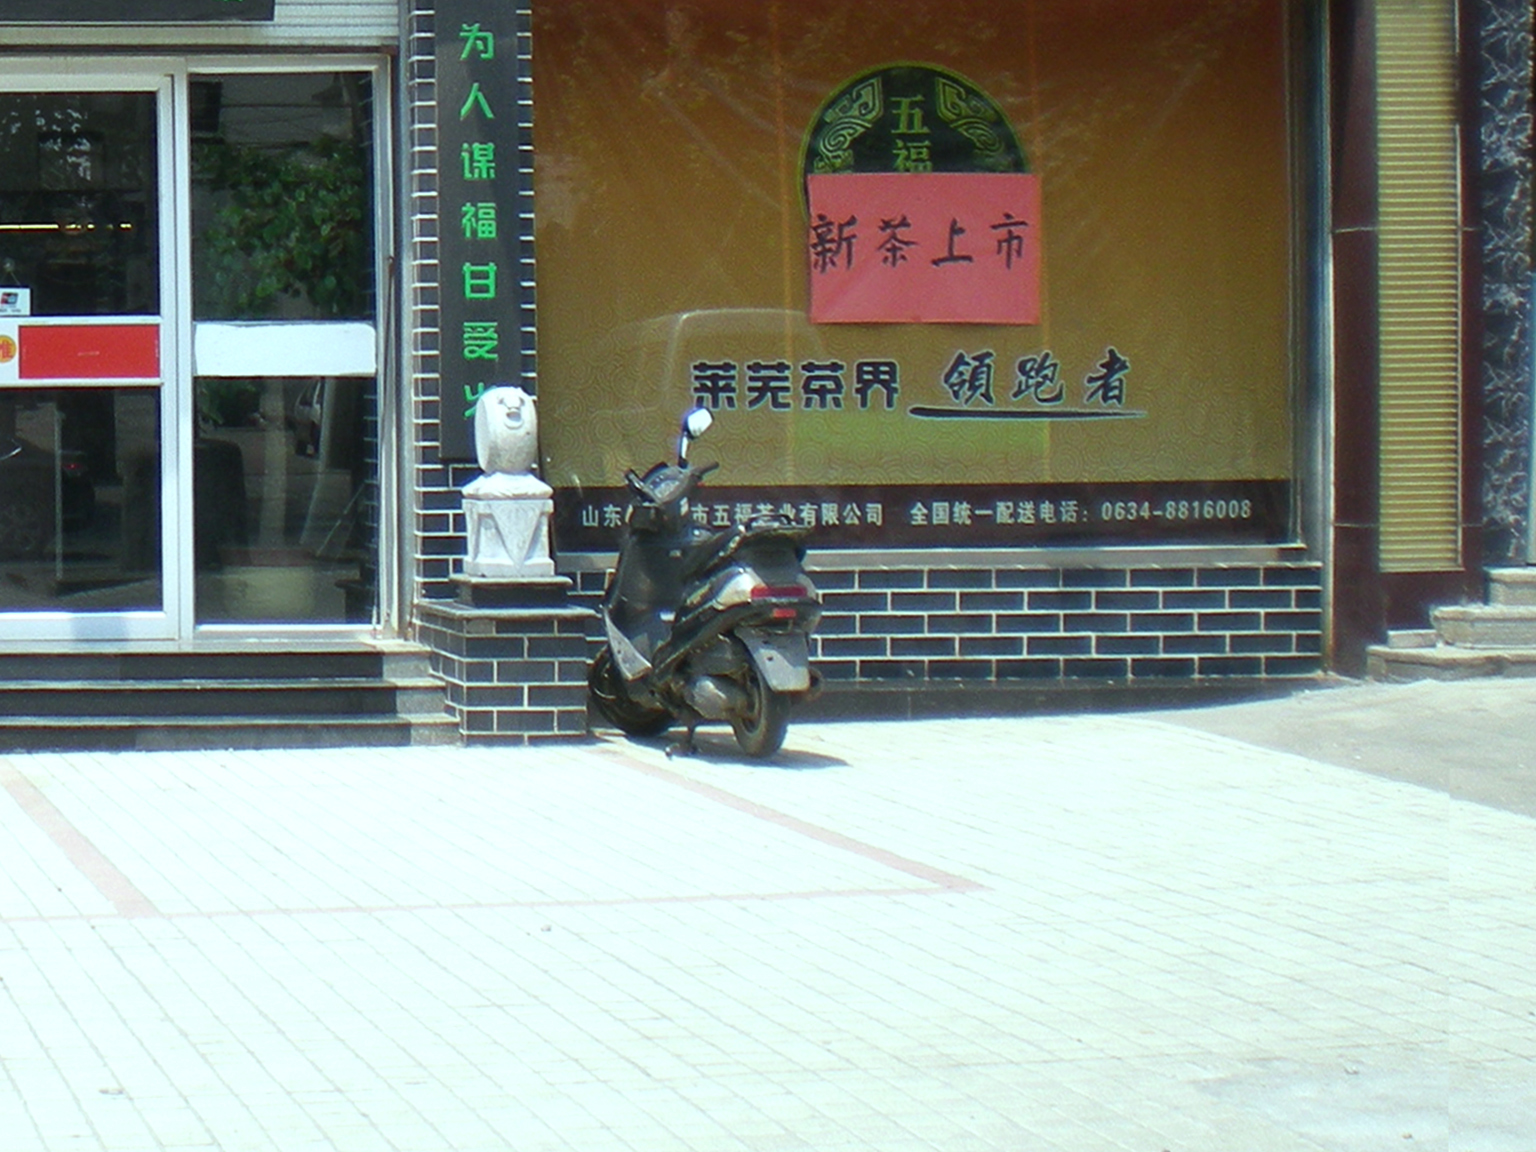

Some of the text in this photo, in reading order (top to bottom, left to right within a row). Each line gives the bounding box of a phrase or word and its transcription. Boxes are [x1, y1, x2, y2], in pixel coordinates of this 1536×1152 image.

[890, 94, 932, 172] 五福
[810, 212, 1029, 273] 新茶上市
[692, 360, 900, 410] 莱芜茶界
[582, 502, 883, 527] 山东市五福茶业有限公司
